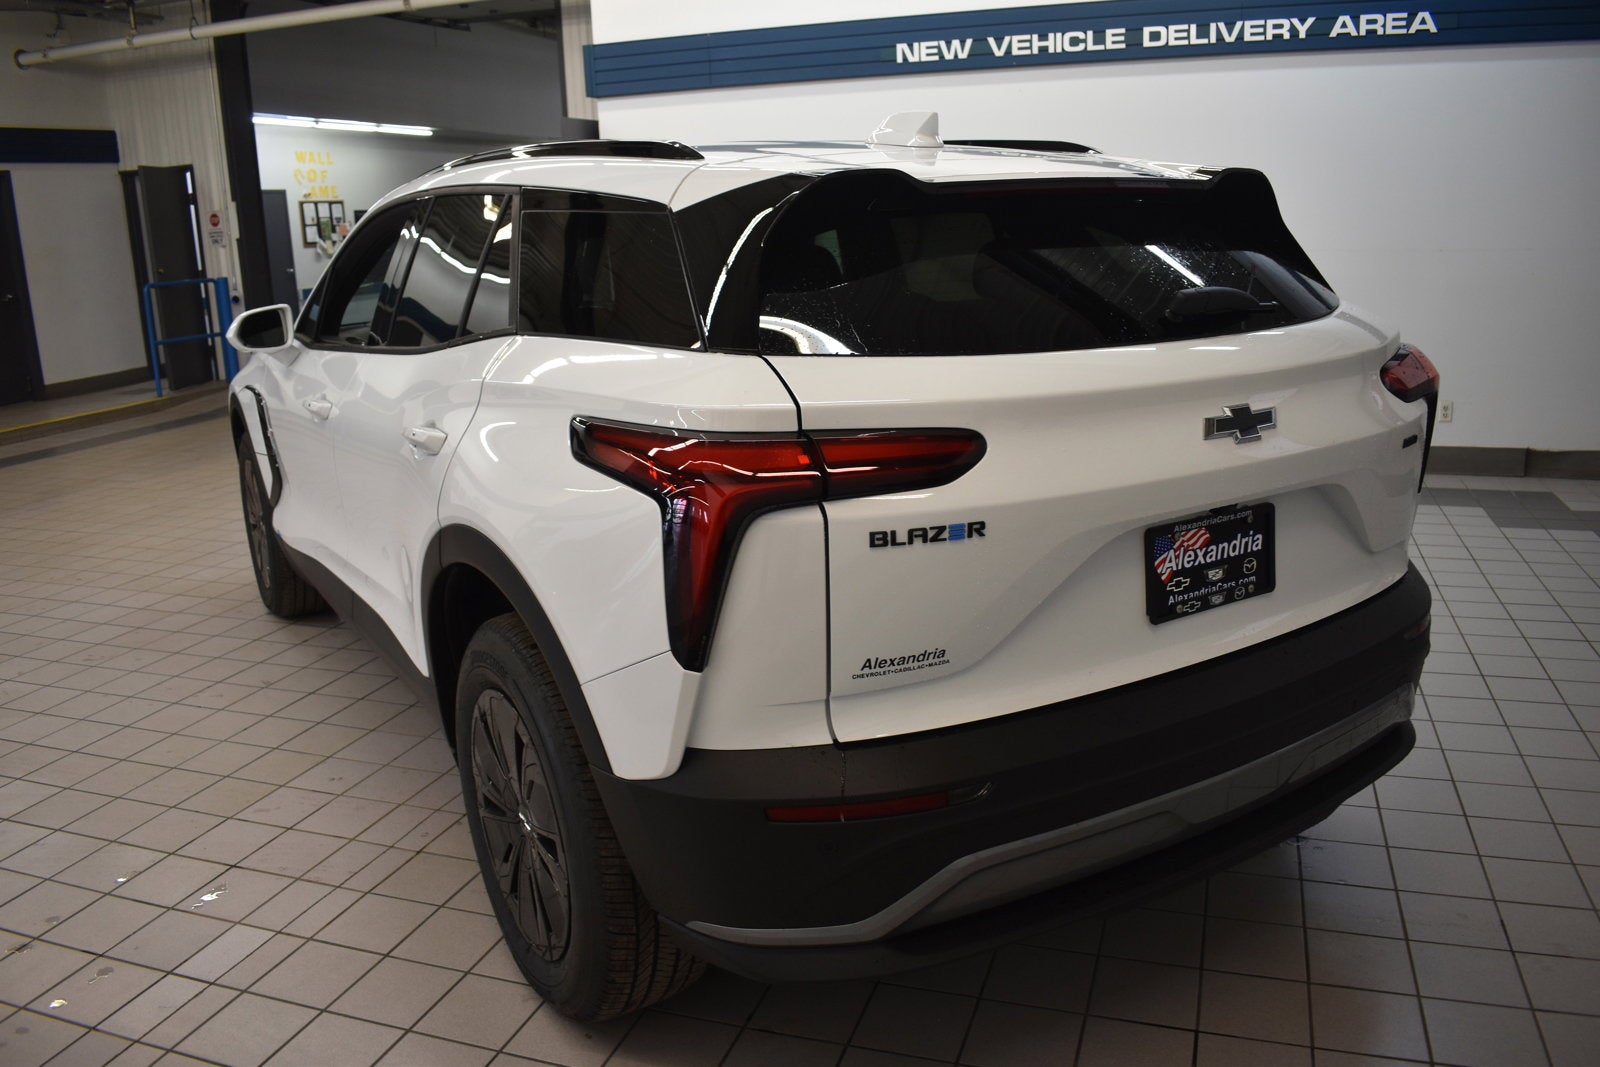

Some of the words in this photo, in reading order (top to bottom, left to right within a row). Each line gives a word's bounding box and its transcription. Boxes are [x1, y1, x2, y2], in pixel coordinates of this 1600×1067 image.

[896, 38, 973, 63] NEW
[987, 28, 1126, 57] VEHICLE
[1142, 17, 1317, 48] DELIVERY
[1329, 11, 1438, 38] AREA
[294, 151, 335, 165] WALL
[306, 168, 328, 182] OF
[1174, 510, 1252, 532] AlexandriaCars.com
[869, 521, 986, 548] BLAZER
[1161, 530, 1264, 574] Alexandria
[1168, 576, 1256, 606] AlexandriaCarscom
[860, 648, 946, 671] Alexandria
